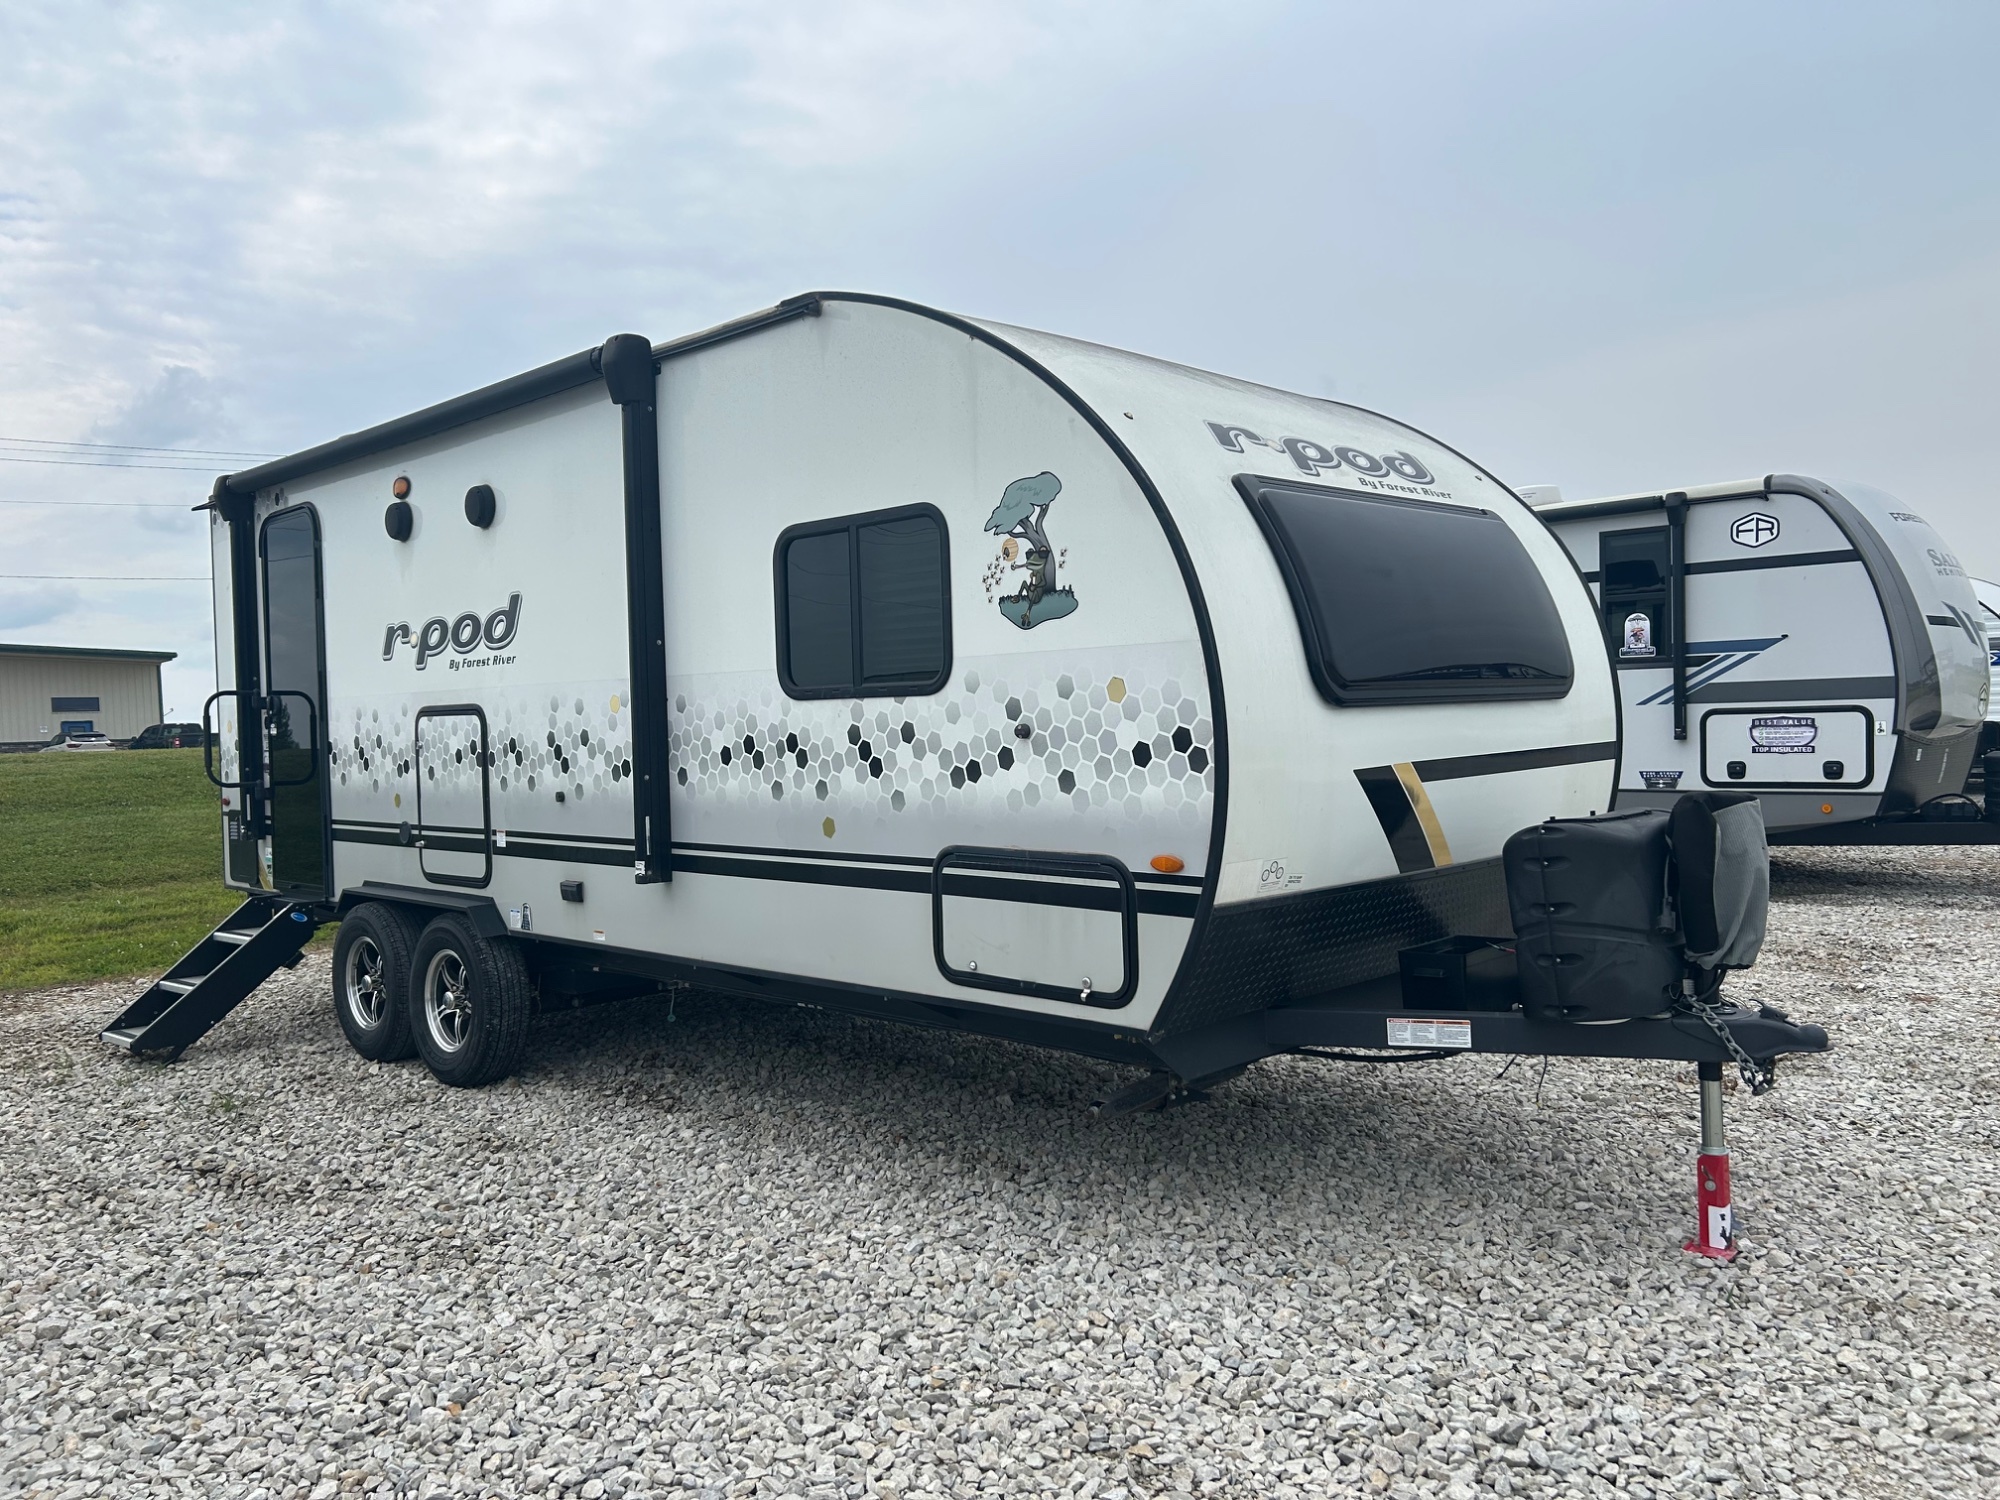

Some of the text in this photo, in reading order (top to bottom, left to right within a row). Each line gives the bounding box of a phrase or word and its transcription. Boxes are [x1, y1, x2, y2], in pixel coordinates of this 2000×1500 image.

[1358, 477, 1452, 499] By Forest River
[449, 654, 517, 671] By Forest River
